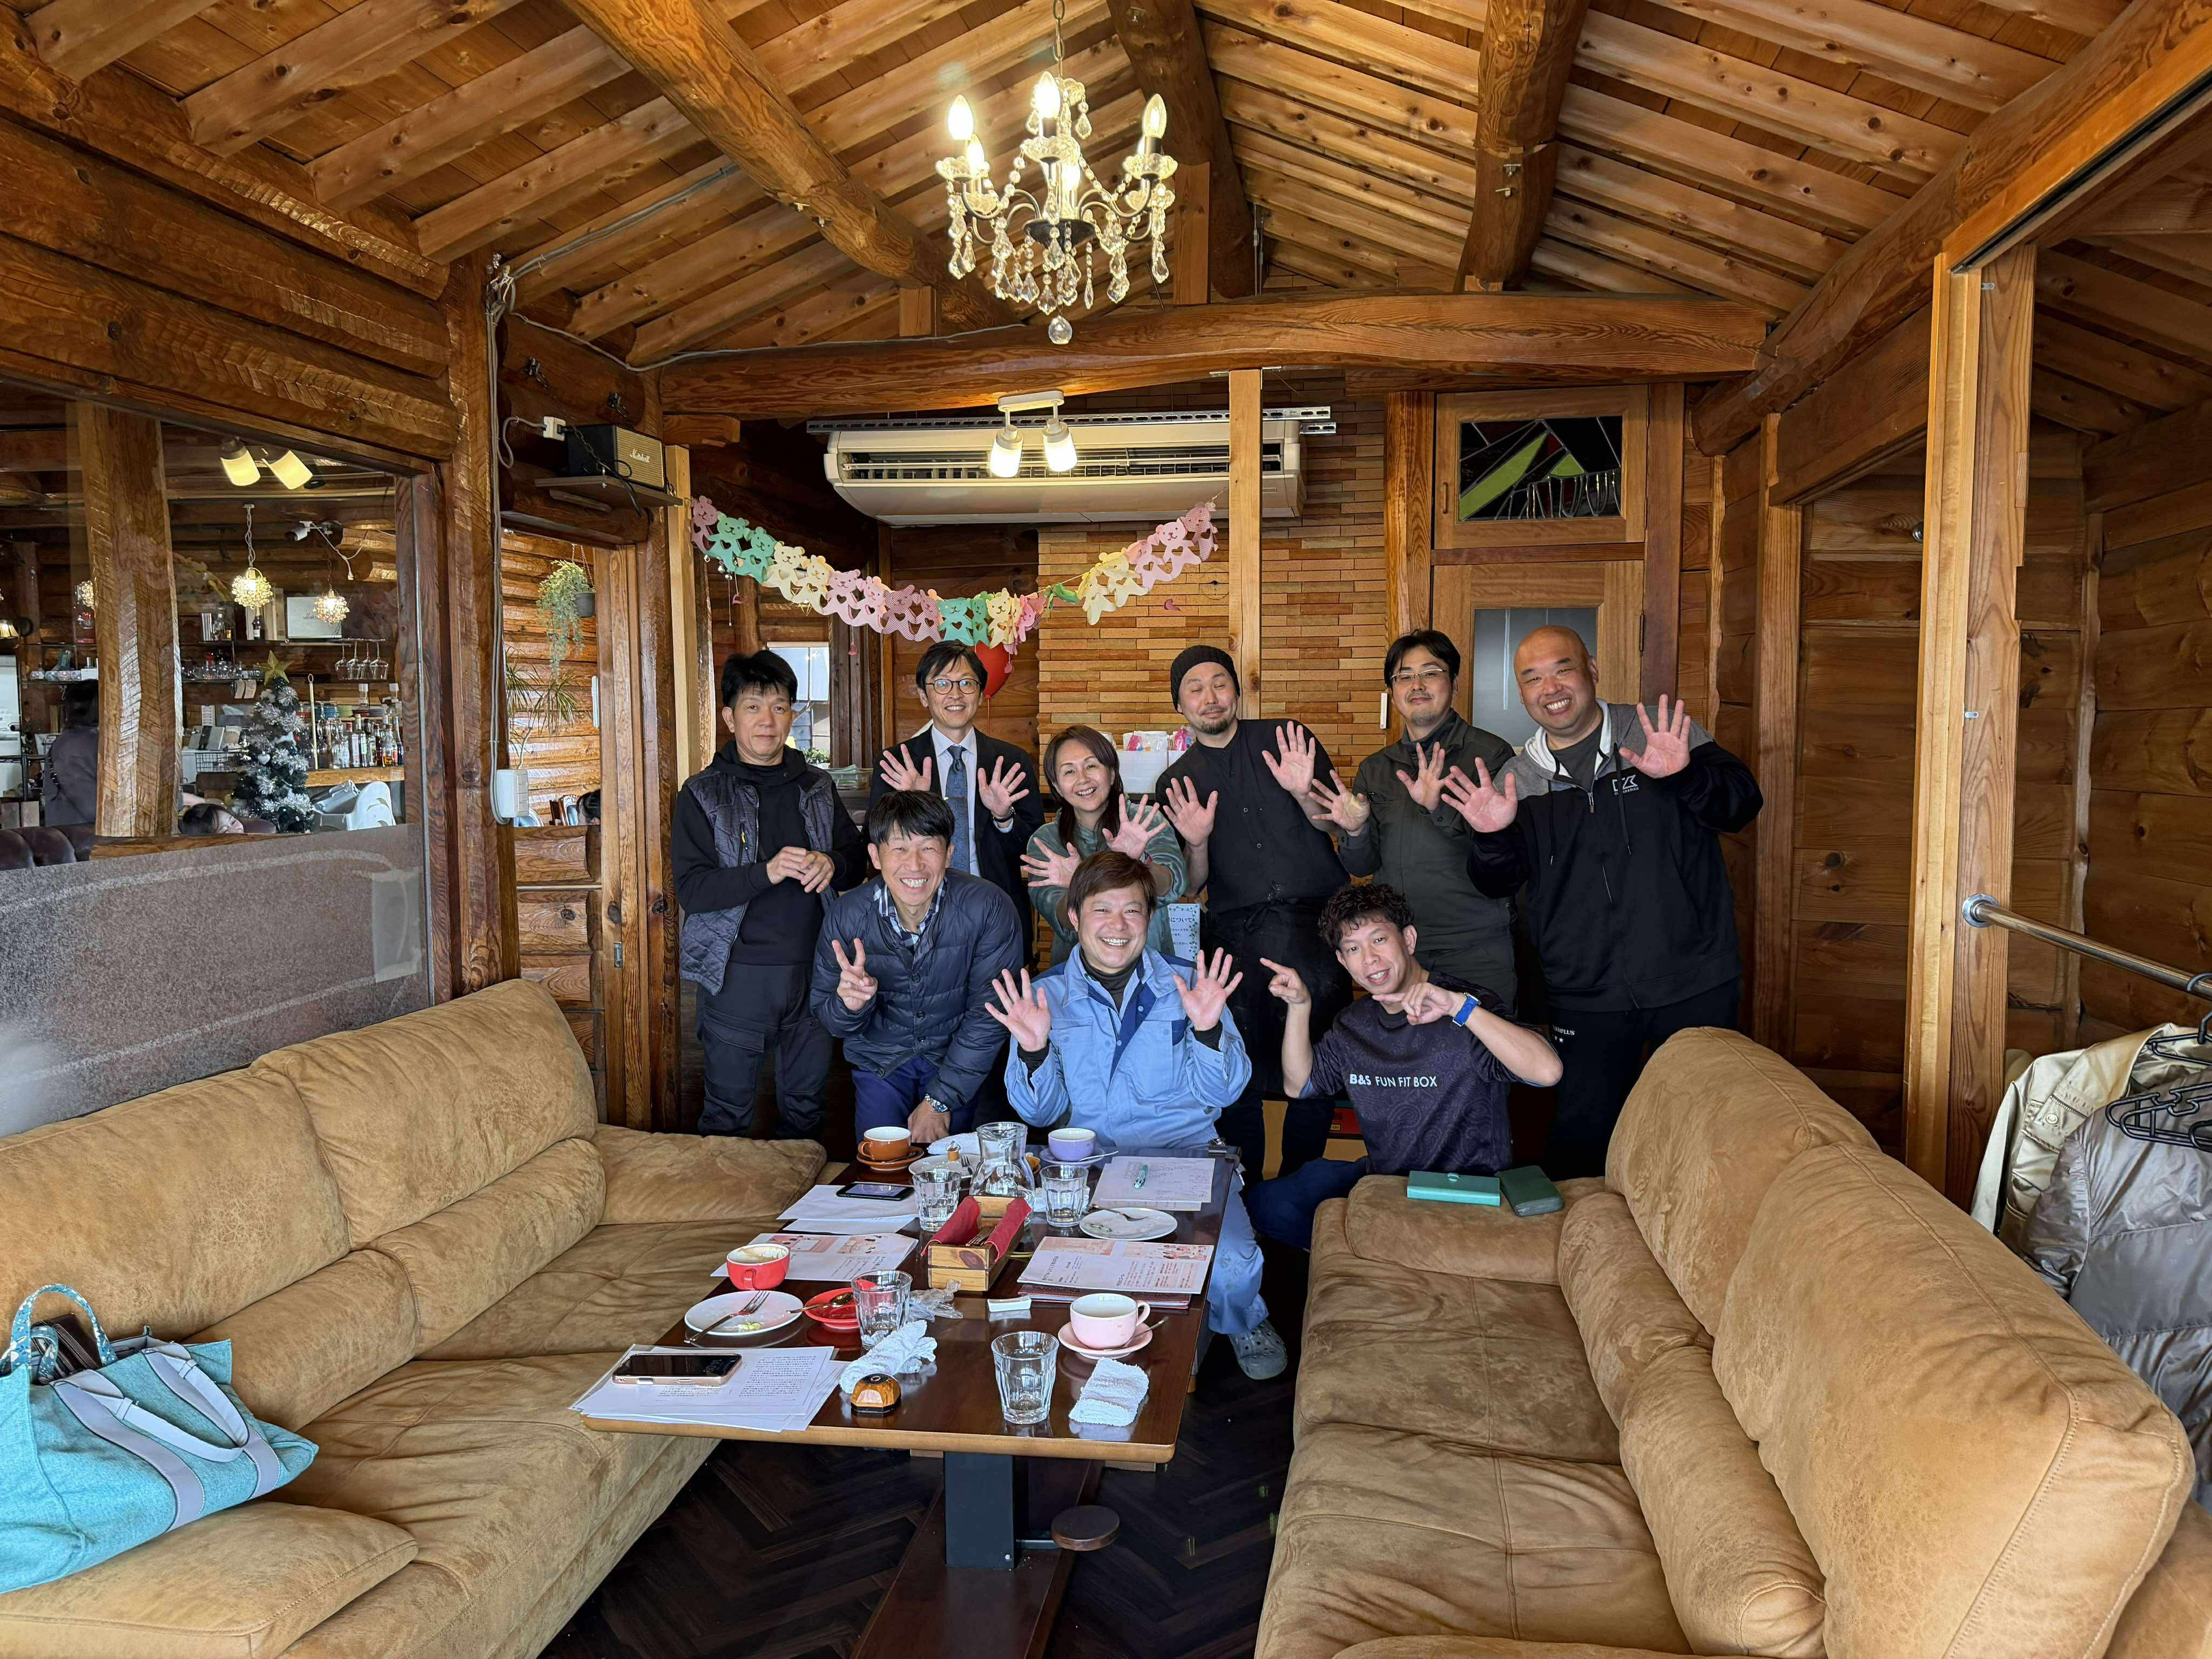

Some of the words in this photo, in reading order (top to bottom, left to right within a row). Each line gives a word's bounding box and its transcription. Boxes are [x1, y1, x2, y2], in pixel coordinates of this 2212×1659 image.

[1350, 1074, 1372, 1085] B&S
[1375, 1076, 1396, 1087] FUN
[1398, 1077, 1411, 1087] FIT
[1413, 1076, 1438, 1087] BOX
